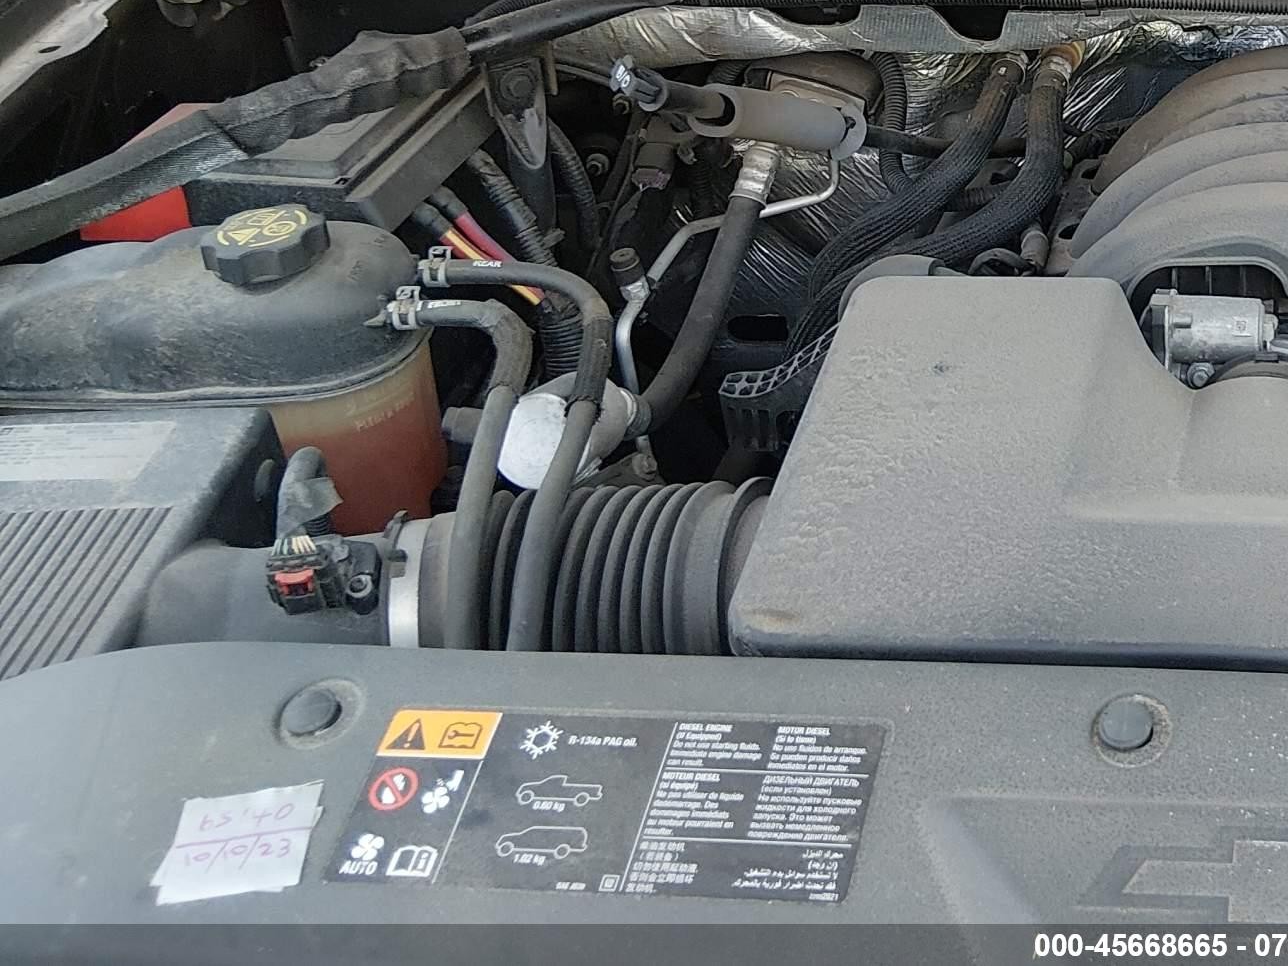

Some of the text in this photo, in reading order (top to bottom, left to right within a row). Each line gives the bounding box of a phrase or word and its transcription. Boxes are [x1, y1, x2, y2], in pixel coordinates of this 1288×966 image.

[472, 260, 502, 268] REAR
[679, 723, 733, 732] DIESEL ENGINE
[777, 726, 831, 735] MOTOR DIESEL
[568, 735, 602, 745] R-134a
[602, 736, 623, 746] PAG
[662, 772, 721, 782] MOTEUR DIESEL
[812, 777, 860, 788] ДВИГАТЕЛЬ
[552, 802, 566, 813] kg
[338, 860, 378, 875] AUTO
